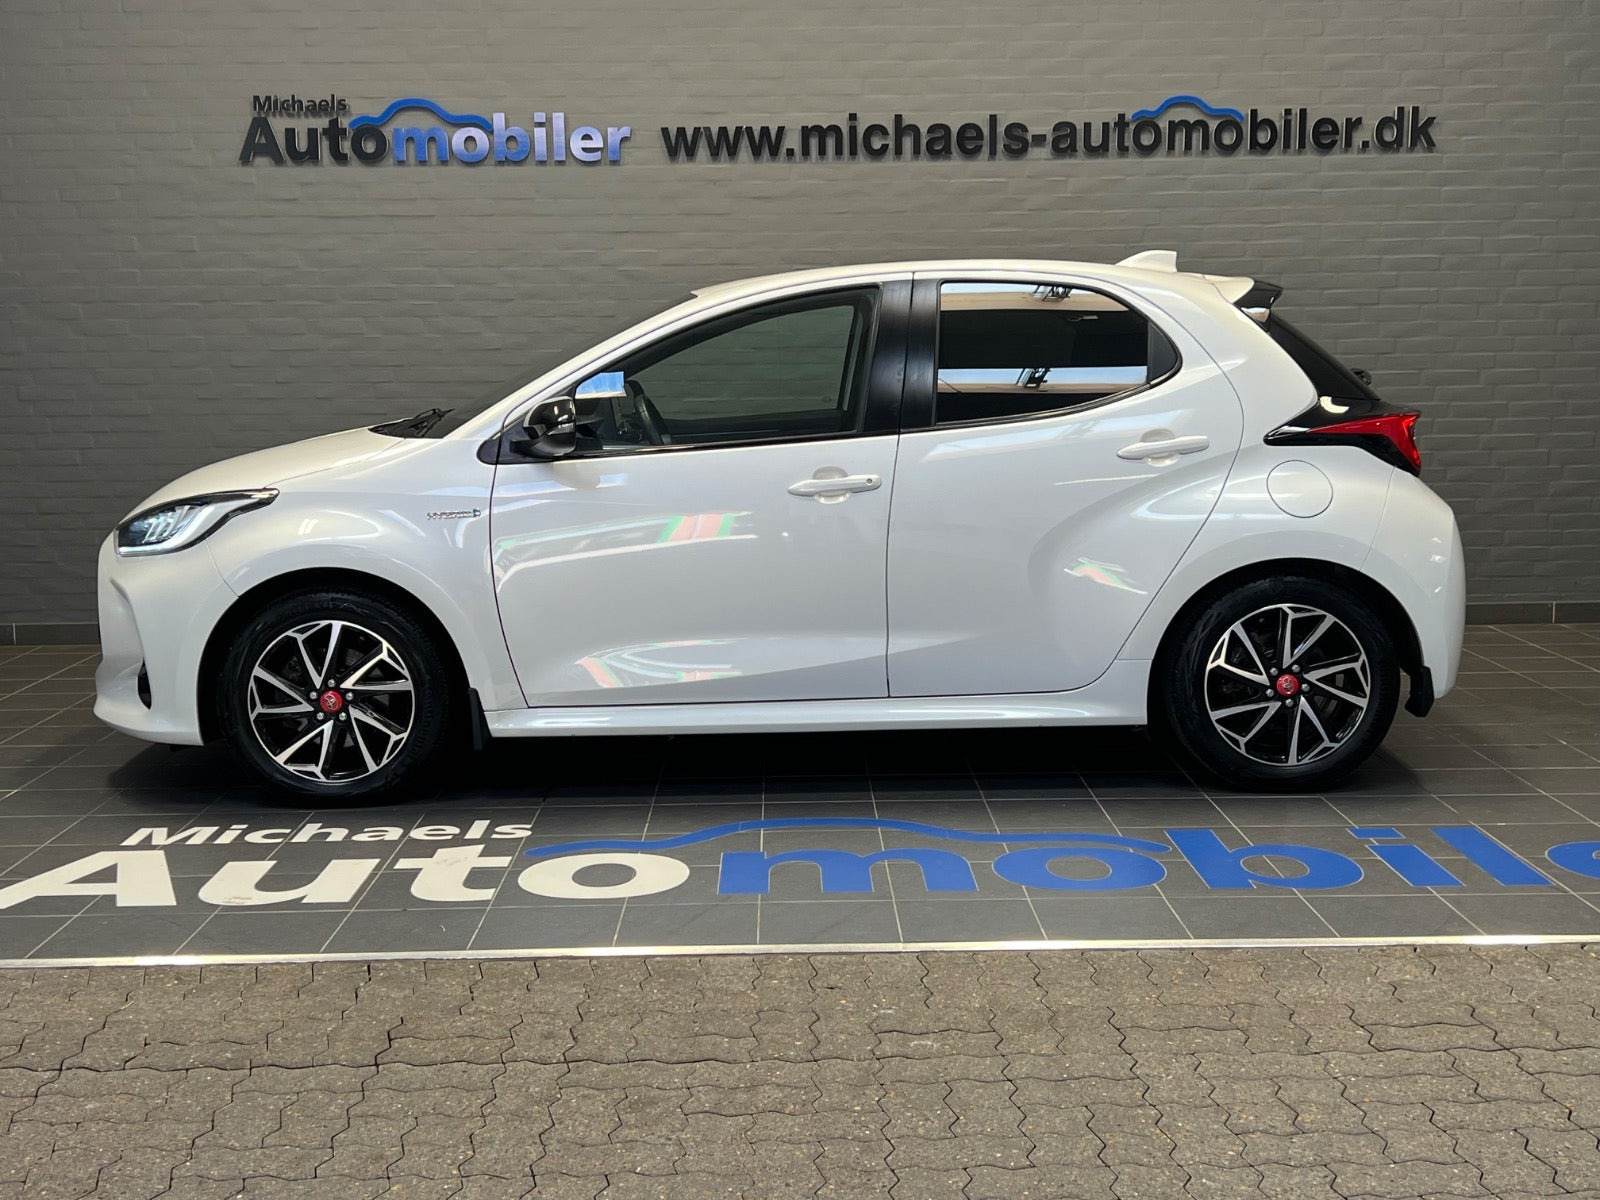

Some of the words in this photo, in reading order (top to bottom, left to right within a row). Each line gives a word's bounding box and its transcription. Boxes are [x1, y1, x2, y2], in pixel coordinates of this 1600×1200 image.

[252, 94, 347, 112] Michaels
[239, 112, 632, 164] Automobiler
[661, 106, 1437, 160] www.michaels-automobiler.dk
[121, 820, 532, 846] Michaels
